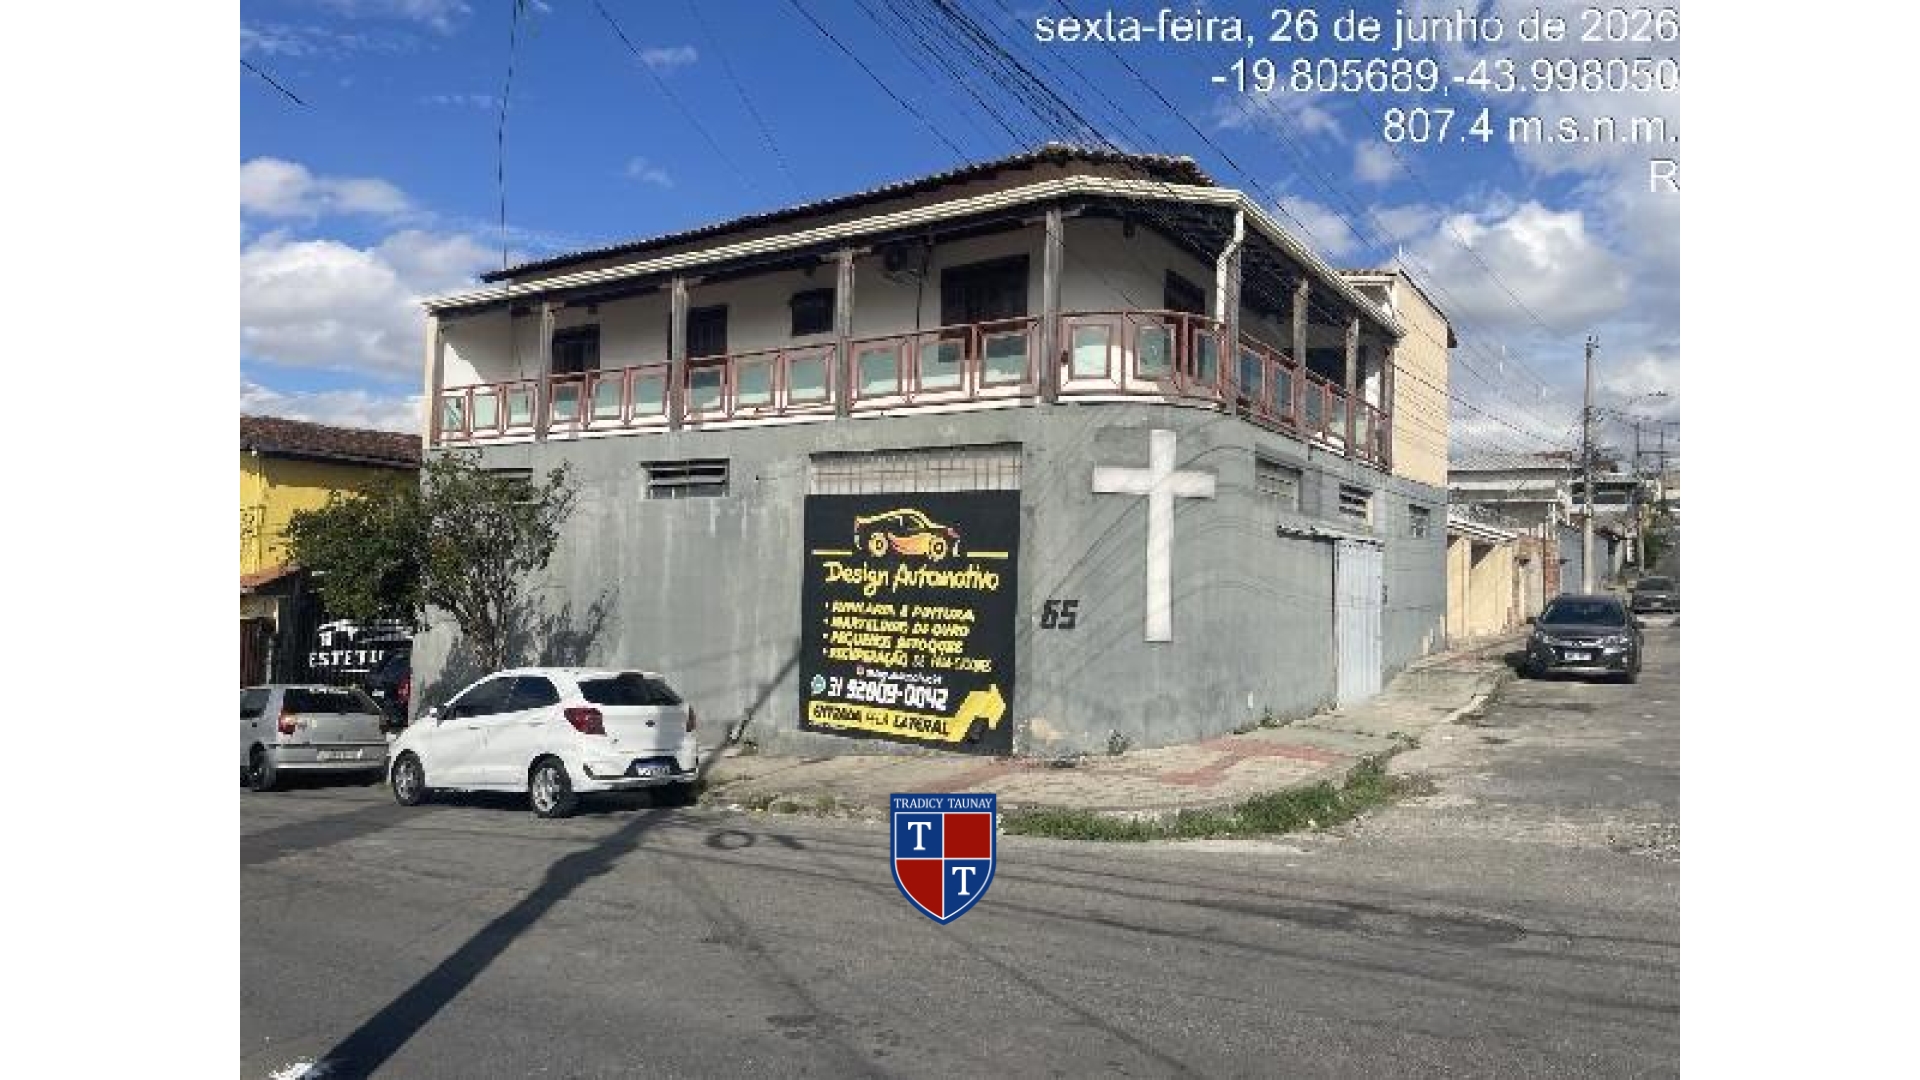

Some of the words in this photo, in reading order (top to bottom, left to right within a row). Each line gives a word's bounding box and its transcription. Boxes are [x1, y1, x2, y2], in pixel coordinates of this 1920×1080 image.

[823, 562, 889, 596] Design
[892, 563, 1000, 593] Automotivo
[1041, 599, 1080, 630] 65
[827, 676, 843, 698] 31
